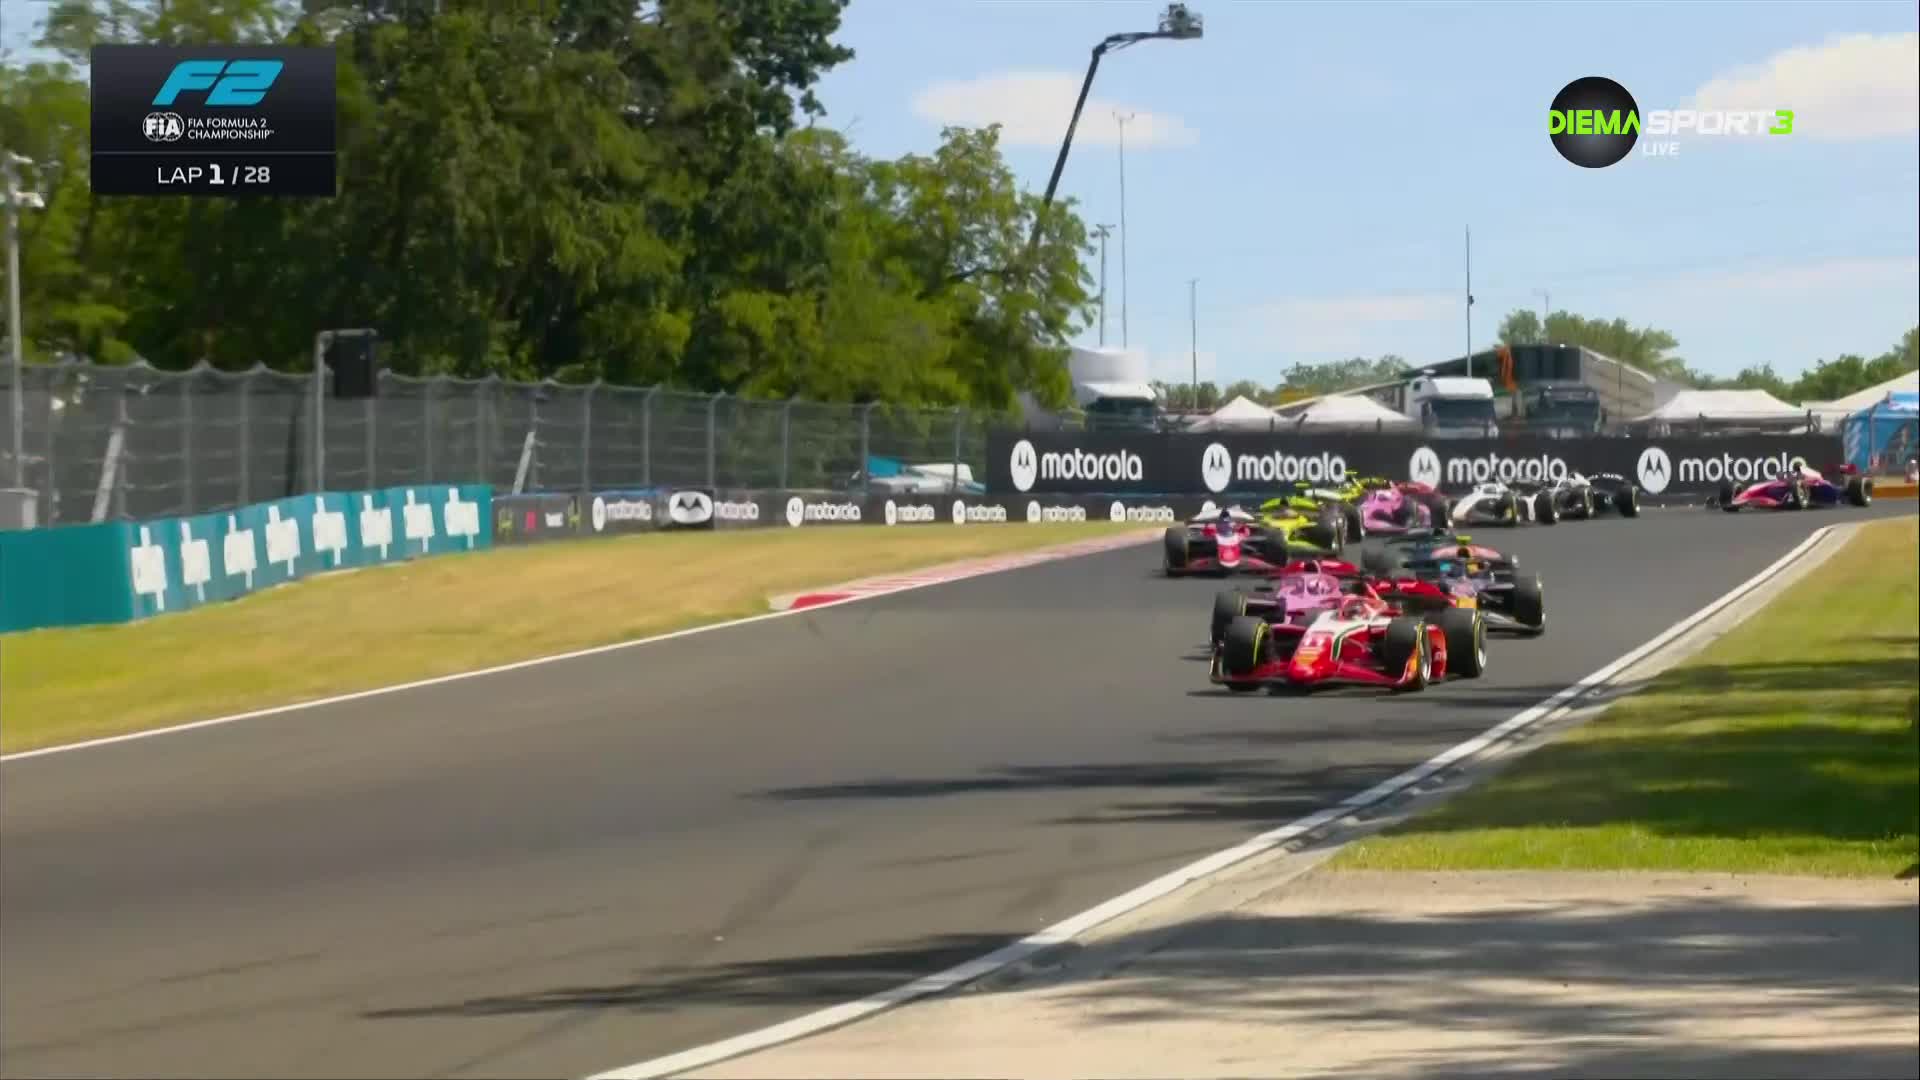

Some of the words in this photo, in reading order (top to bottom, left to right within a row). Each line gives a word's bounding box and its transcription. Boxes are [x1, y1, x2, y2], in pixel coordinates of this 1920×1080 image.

[1041, 448, 1143, 481] motorola
[1236, 451, 1346, 482] motorola
[1447, 453, 1568, 483] motorola
